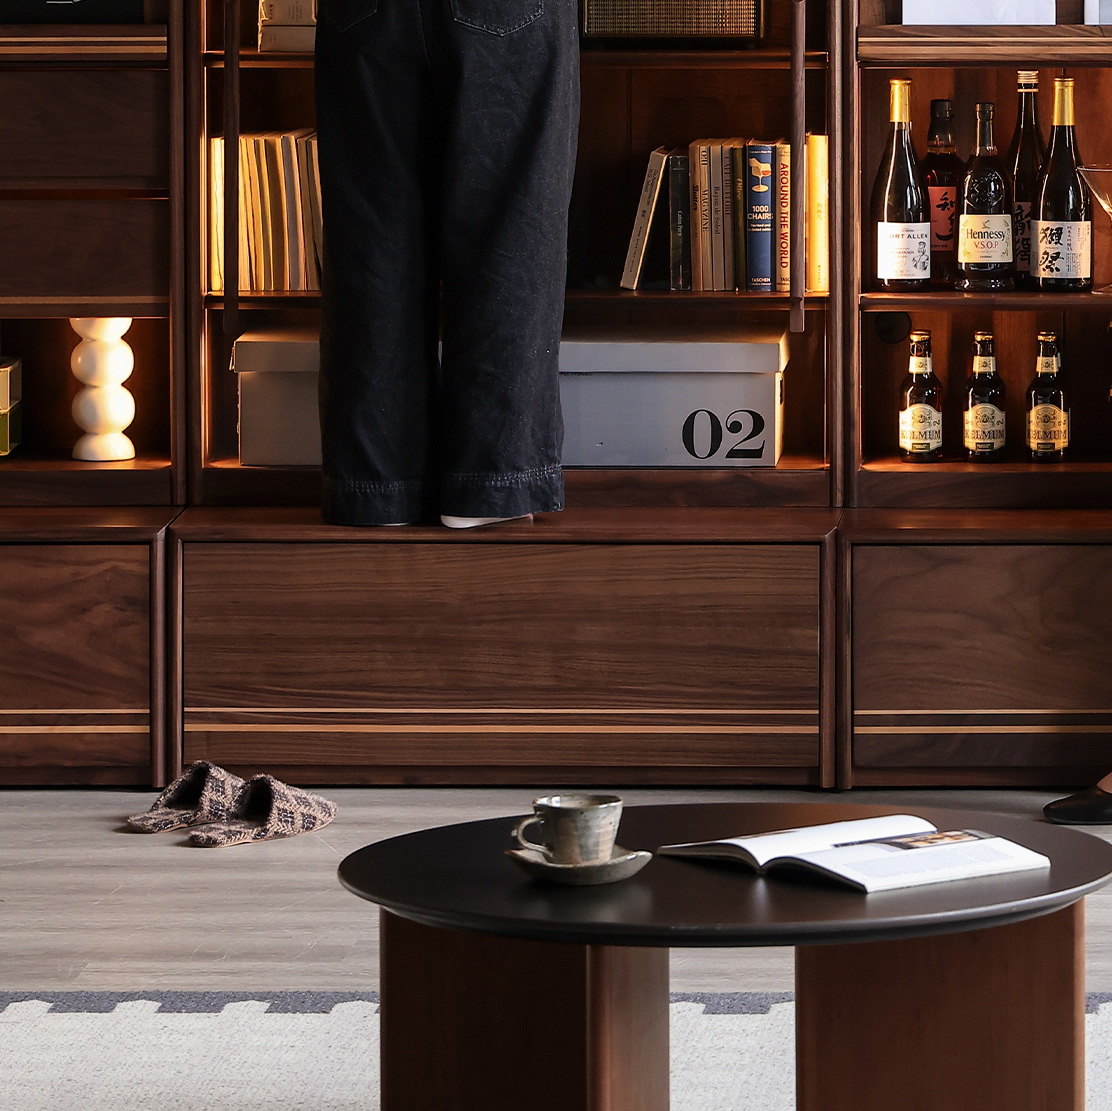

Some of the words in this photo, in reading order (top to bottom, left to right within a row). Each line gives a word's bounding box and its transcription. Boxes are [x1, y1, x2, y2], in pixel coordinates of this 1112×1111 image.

[780, 162, 789, 208] AROUND
[701, 189, 709, 233] MAGAZINE
[747, 212, 774, 220] CHAIRS
[752, 205, 769, 213] 1000
[780, 210, 789, 229] THE
[966, 228, 1006, 241] Hennessy
[780, 232, 789, 269] WORLD
[681, 408, 767, 461] 02
